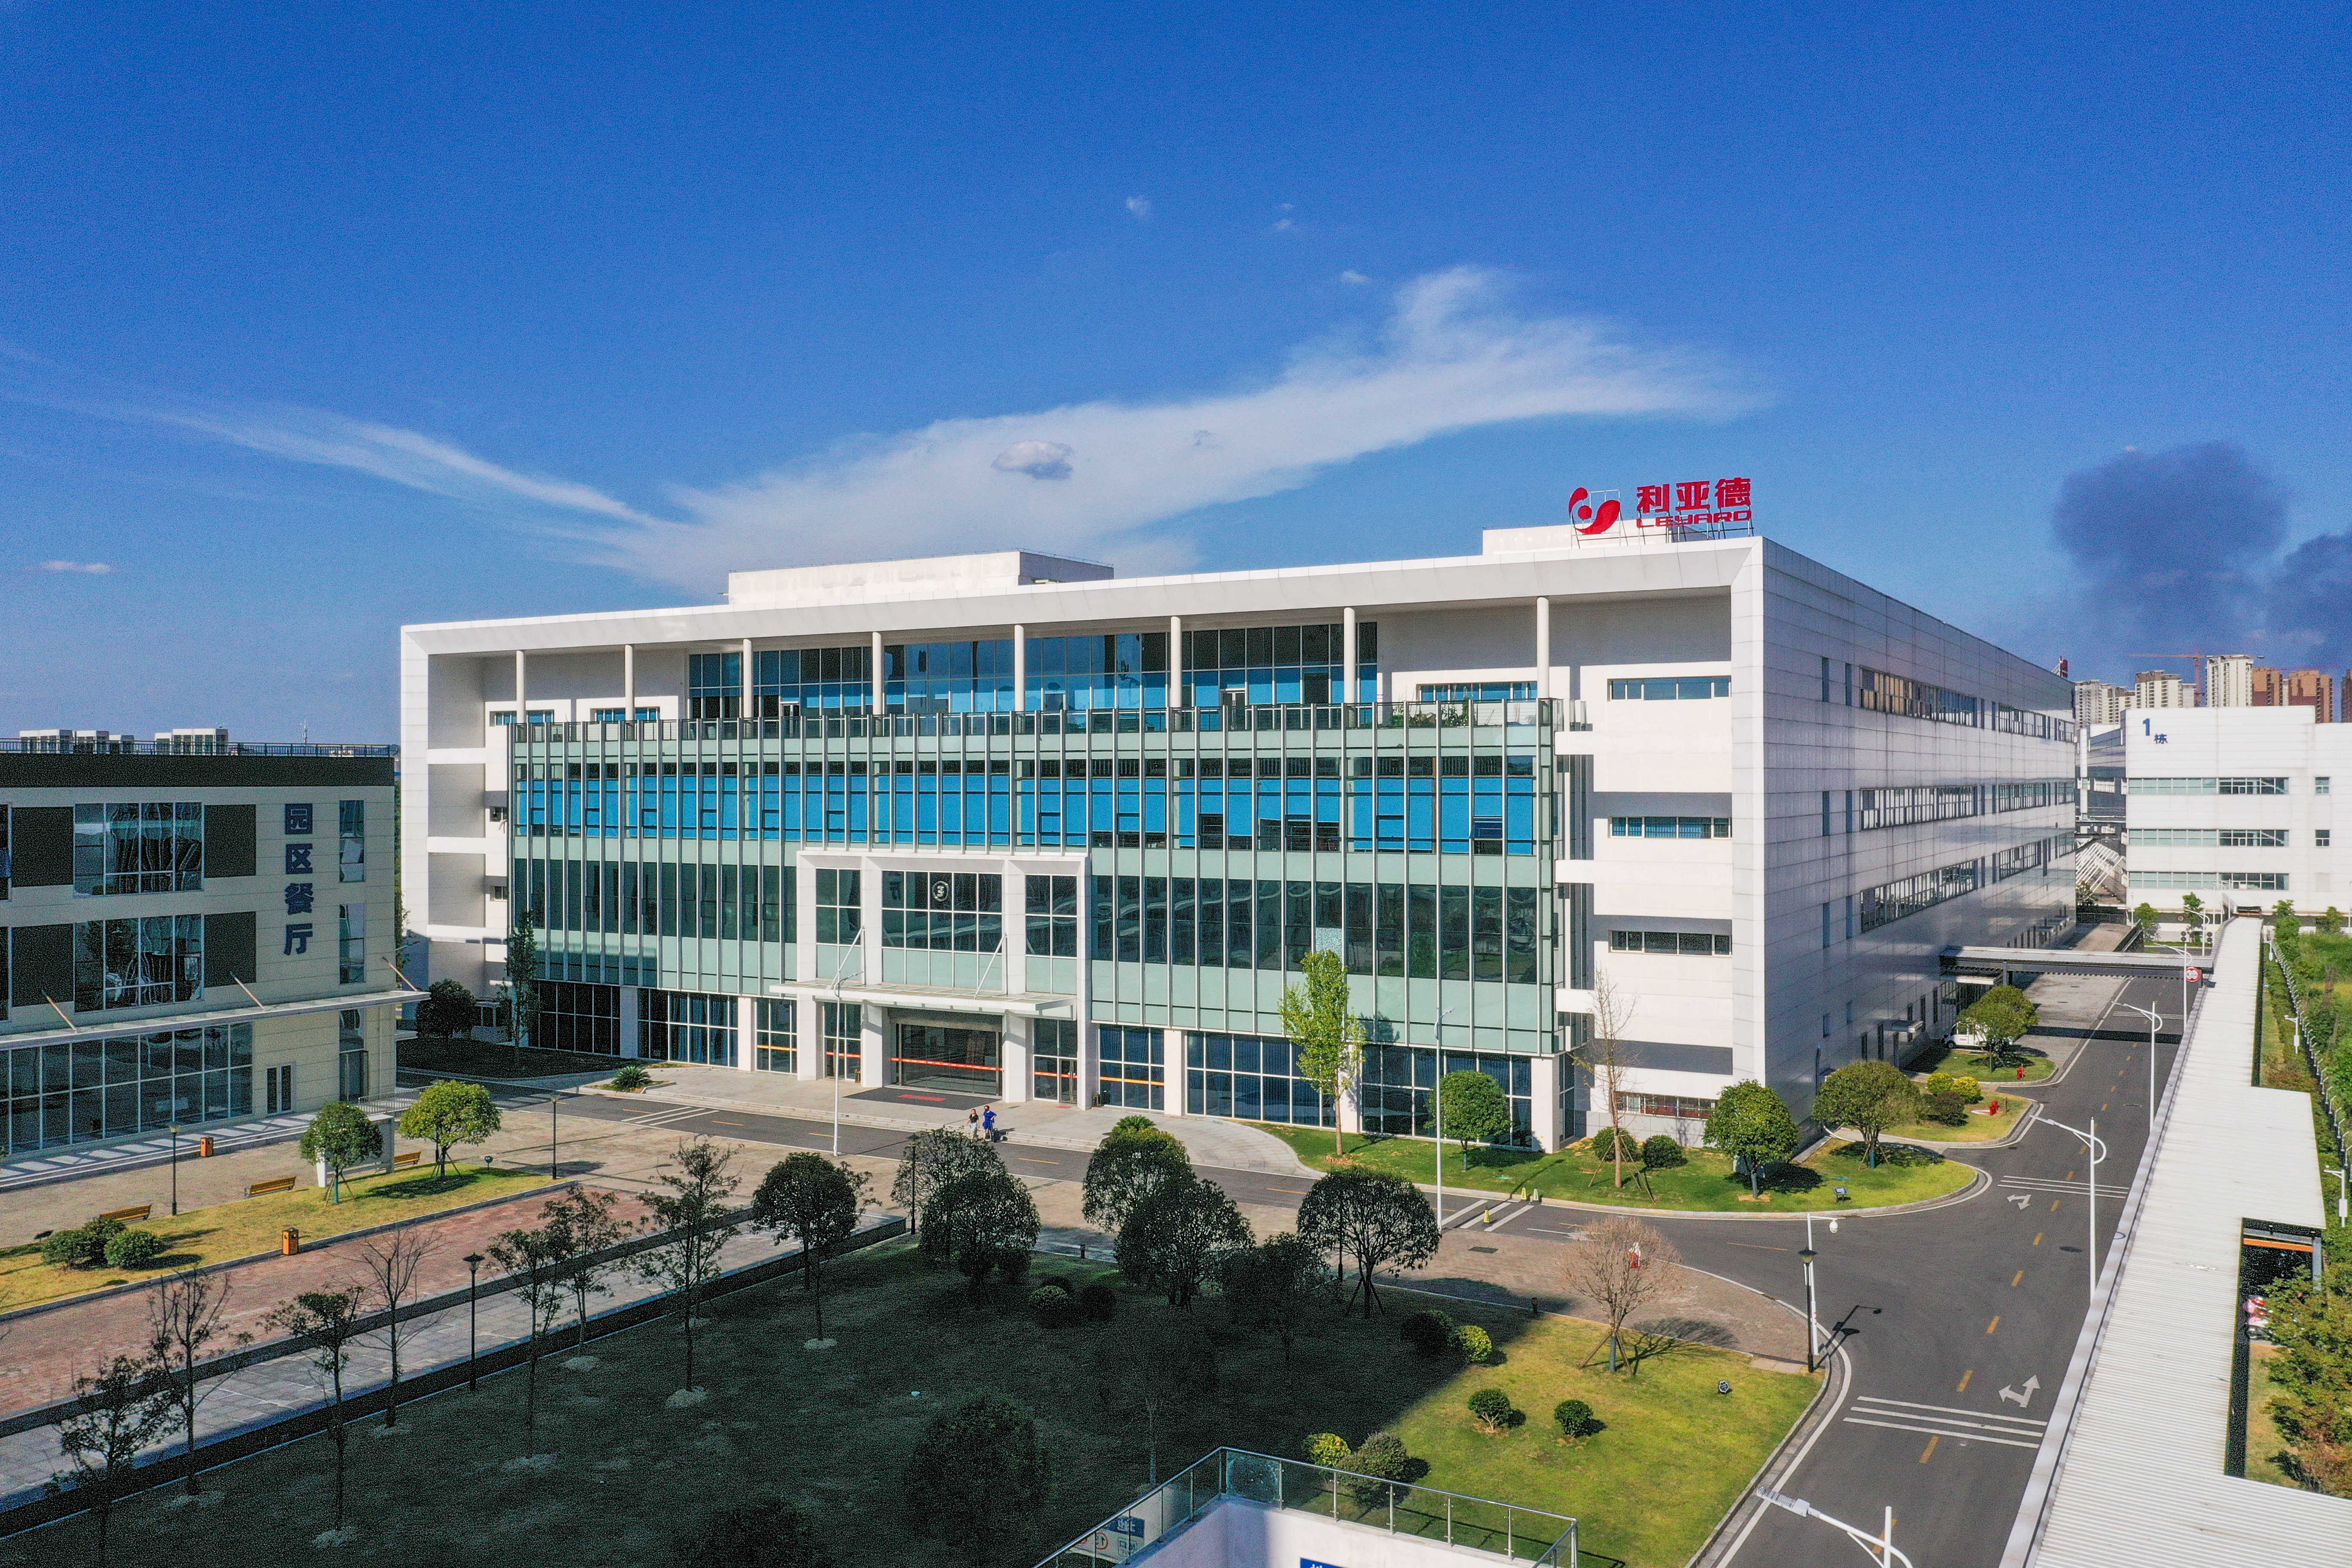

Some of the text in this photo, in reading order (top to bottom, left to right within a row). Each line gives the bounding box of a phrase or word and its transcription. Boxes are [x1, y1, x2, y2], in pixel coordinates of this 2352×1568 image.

[1636, 477, 1752, 513] 利亚德
[1636, 510, 1752, 528] LEYARD
[284, 803, 314, 956] 园区餐厅
